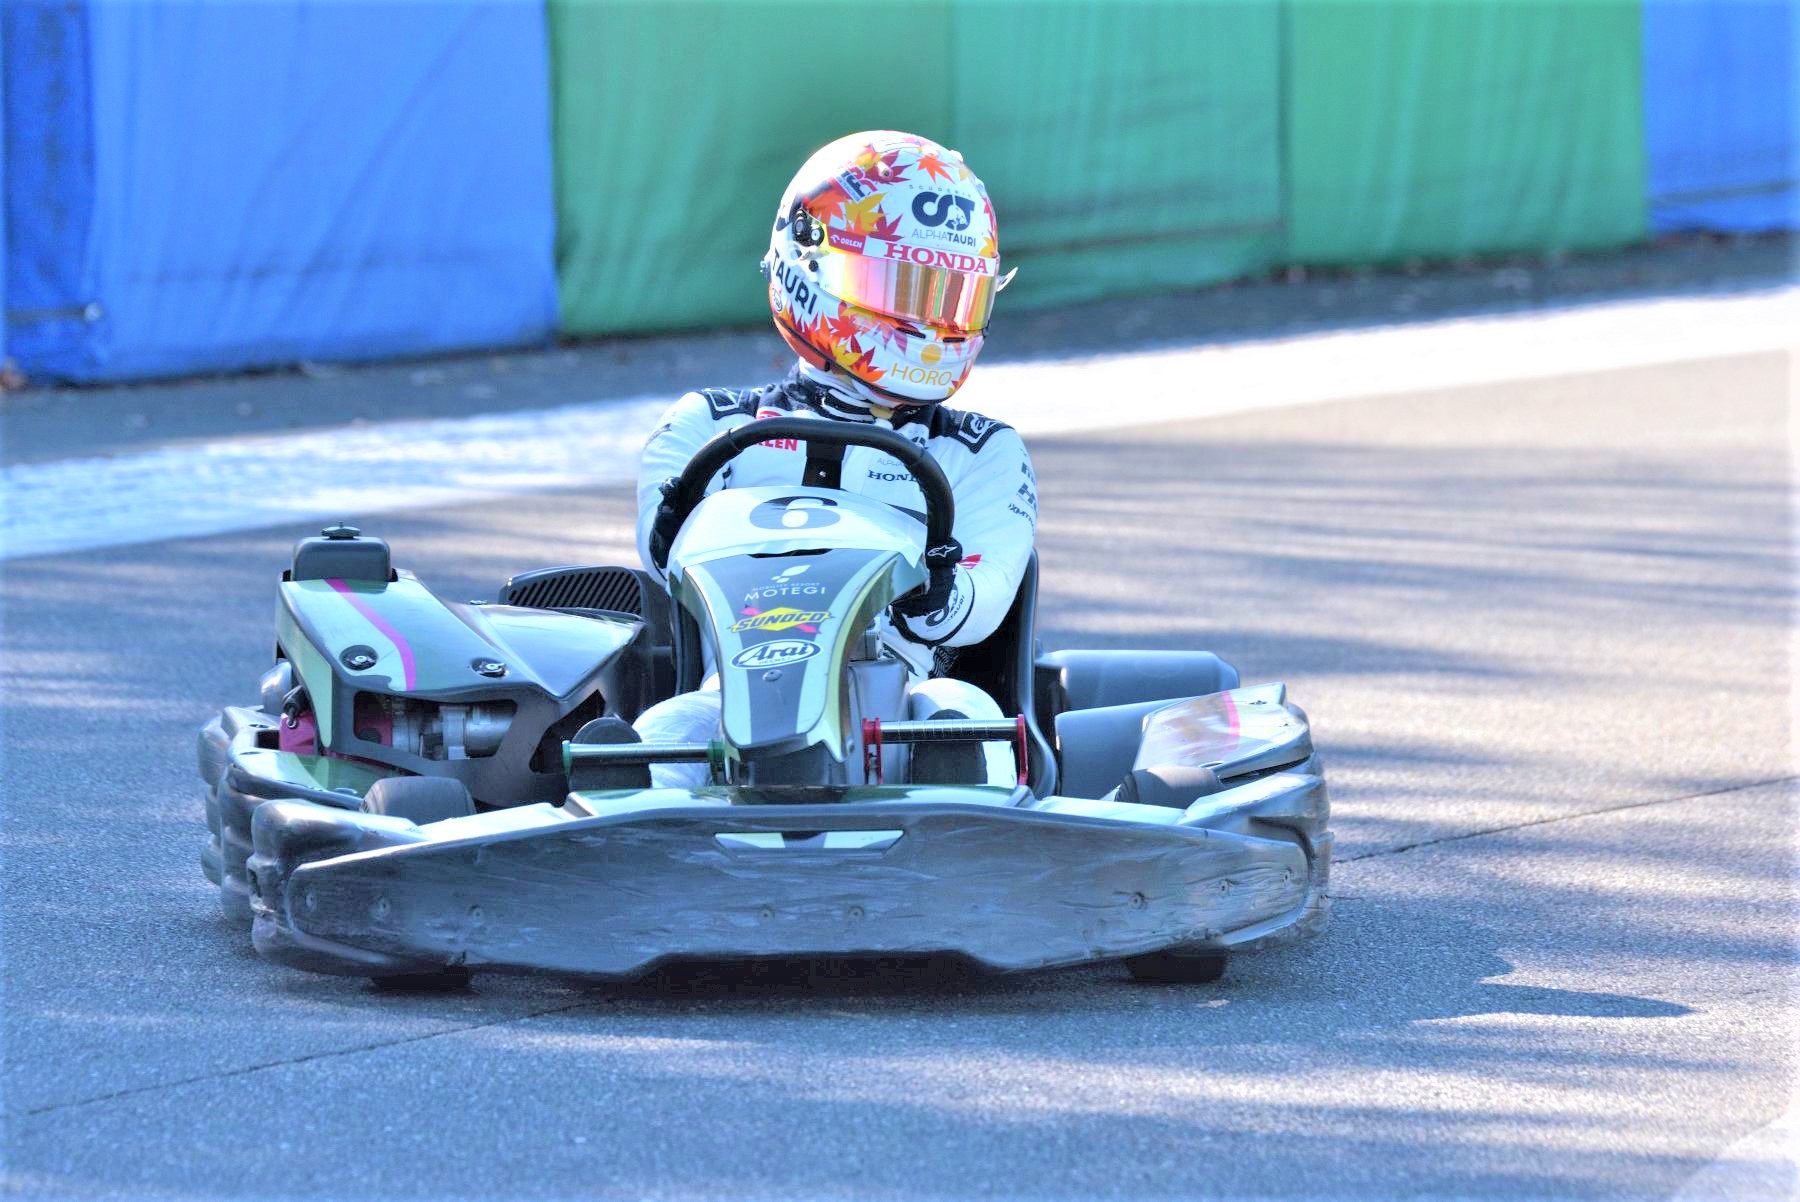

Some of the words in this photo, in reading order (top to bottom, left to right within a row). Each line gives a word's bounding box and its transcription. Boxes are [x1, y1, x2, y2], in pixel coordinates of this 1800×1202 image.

[840, 237, 863, 249] ORLEN
[911, 228, 977, 248] ALPHATAURI
[883, 242, 989, 274] HONDA
[772, 246, 818, 316] TAURI
[756, 438, 798, 452] LEN
[867, 469, 919, 482] HON
[749, 496, 841, 530] 6
[744, 586, 826, 602] MOTEGI
[731, 611, 831, 633] SUNOCO
[739, 643, 811, 664] Arai
